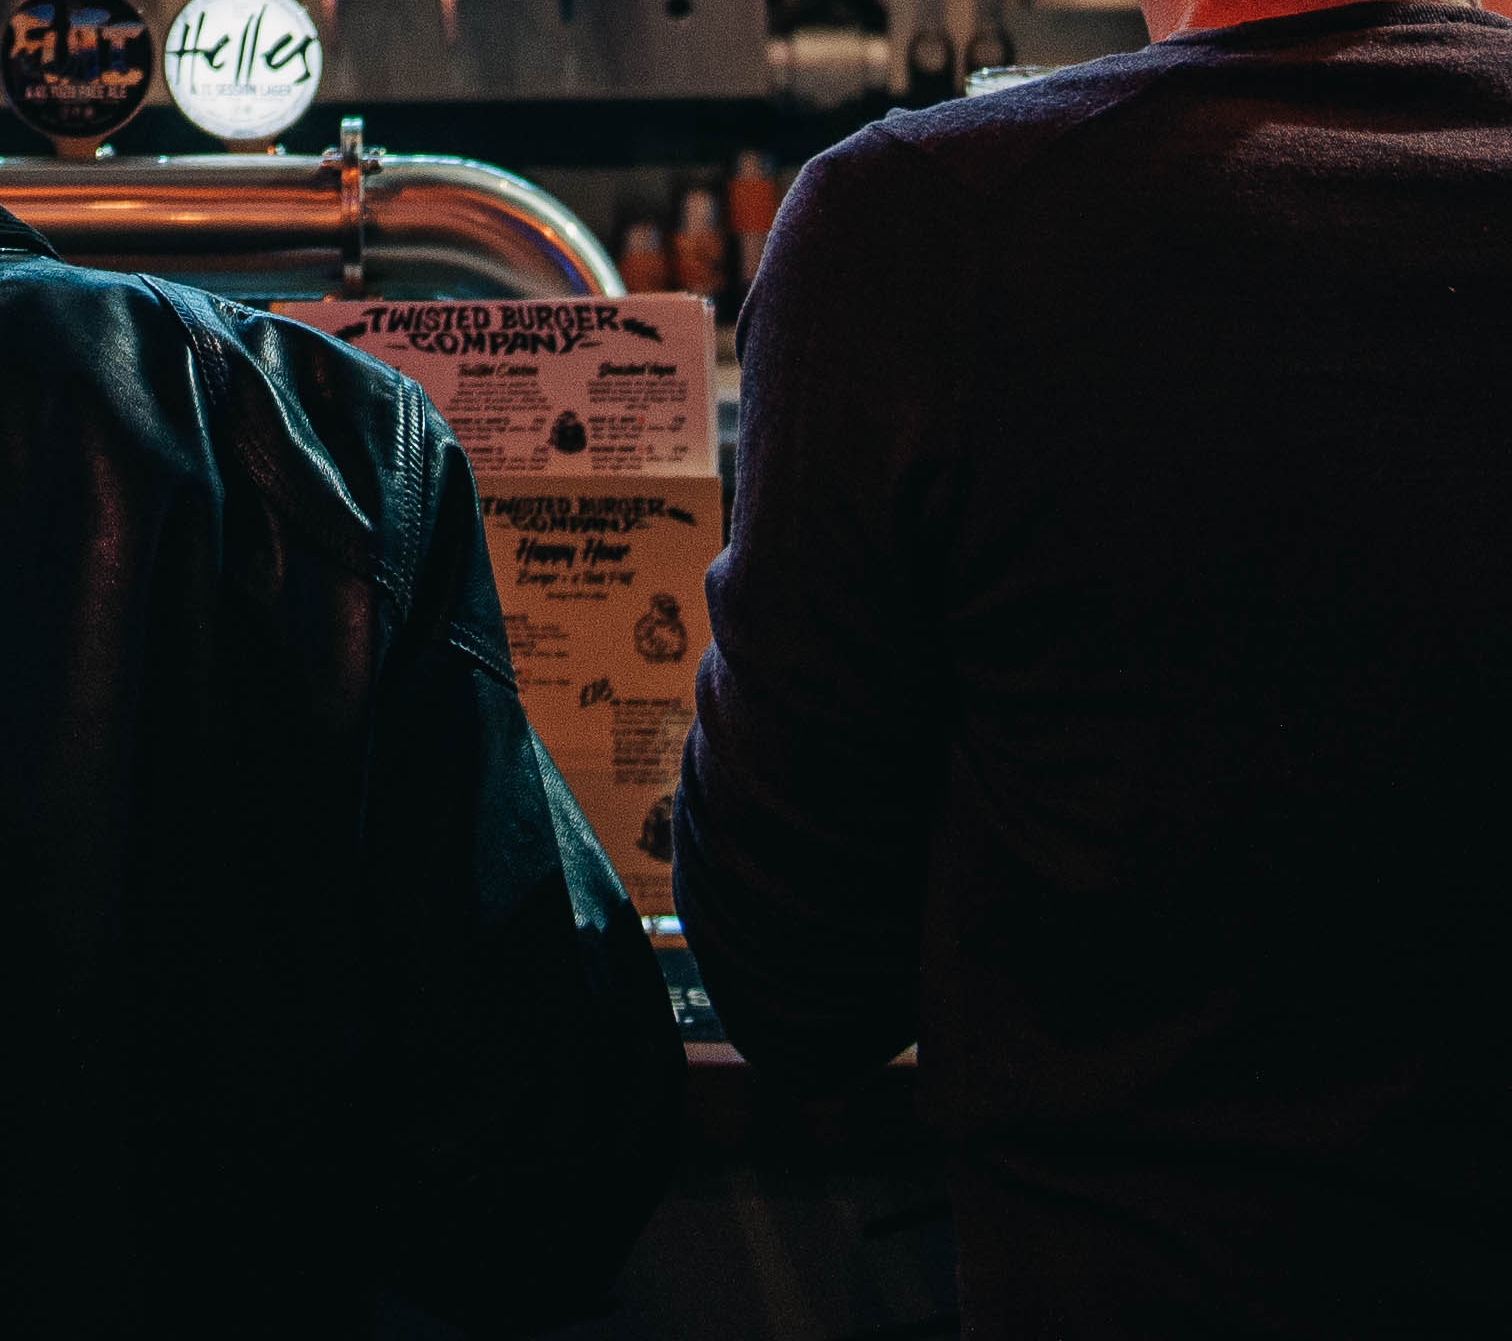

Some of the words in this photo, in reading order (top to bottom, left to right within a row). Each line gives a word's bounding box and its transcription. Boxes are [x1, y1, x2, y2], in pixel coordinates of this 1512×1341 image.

[362, 307, 491, 334] TWISTED
[499, 304, 620, 332] BURGER
[406, 330, 579, 357] COMPANY
[480, 496, 572, 516] TWISTED
[578, 496, 667, 517] BURGER
[509, 515, 640, 534] COMPANY
[515, 538, 577, 568] Happy
[582, 538, 632, 566] Hour
